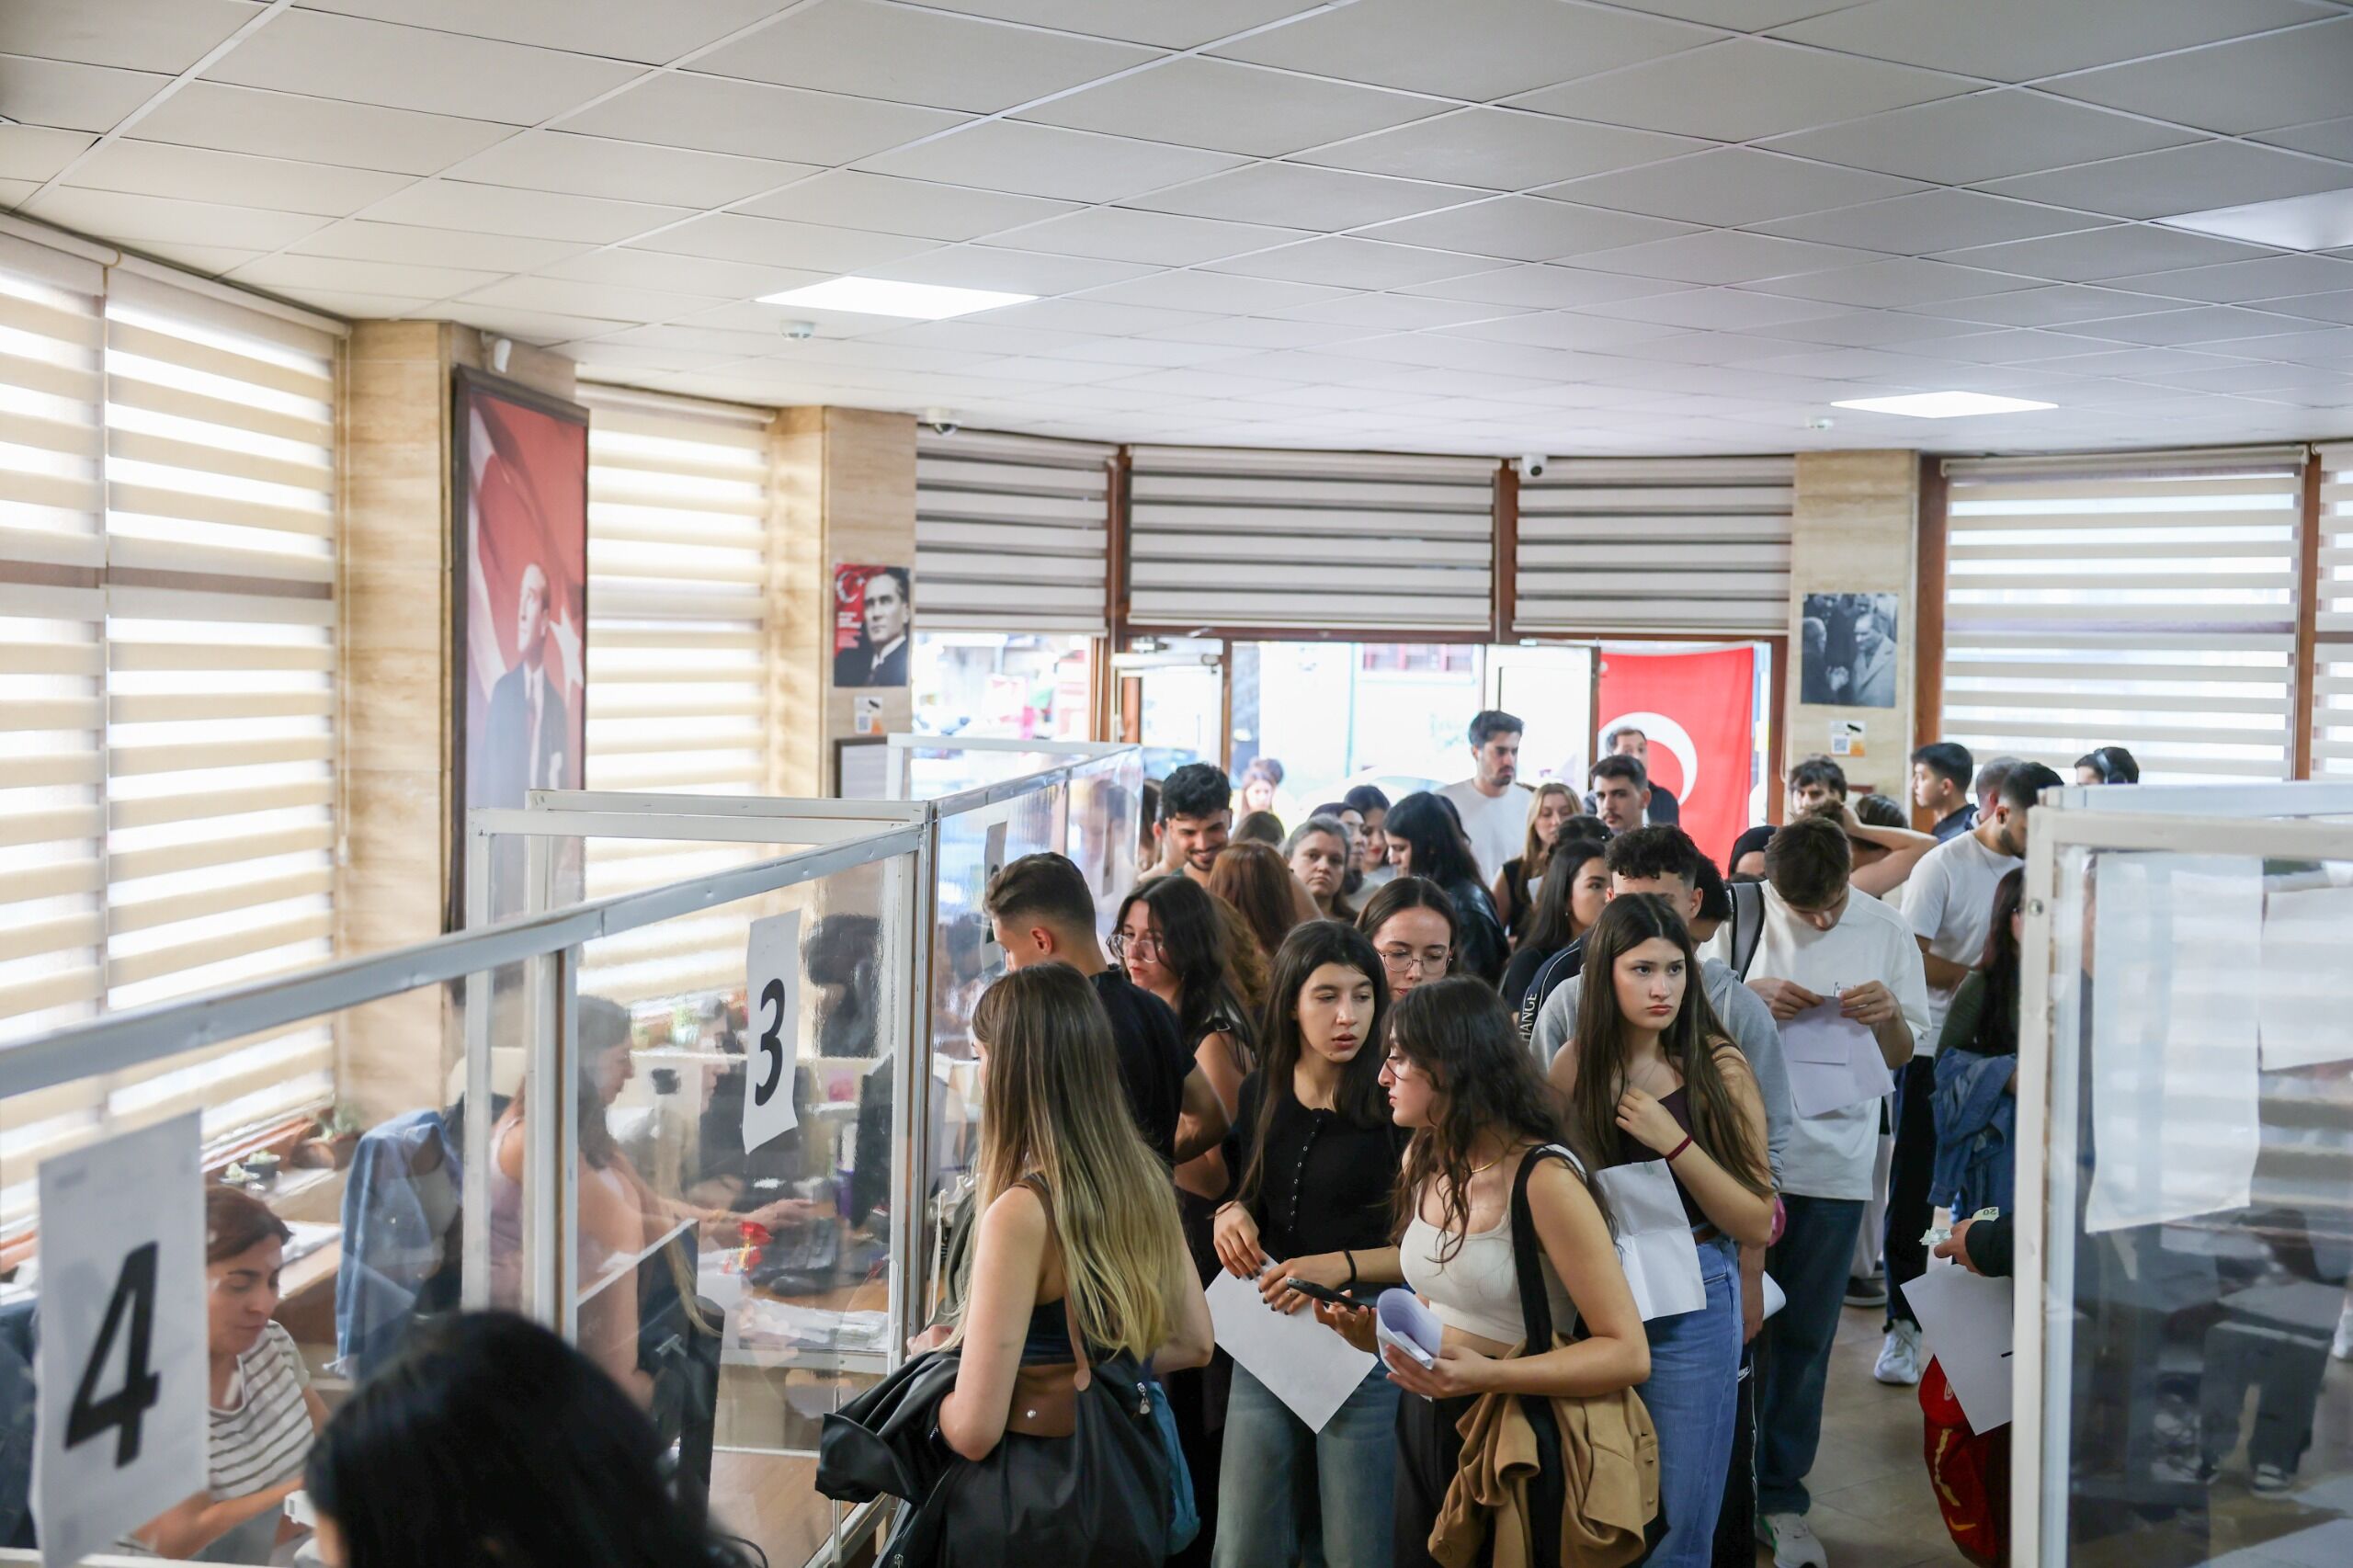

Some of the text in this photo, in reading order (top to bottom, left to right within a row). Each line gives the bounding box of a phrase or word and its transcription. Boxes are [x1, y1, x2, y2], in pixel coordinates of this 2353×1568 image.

[755, 977, 786, 1107] 3
[1983, 1208, 1997, 1216] 20
[64, 1241, 161, 1469] 4
